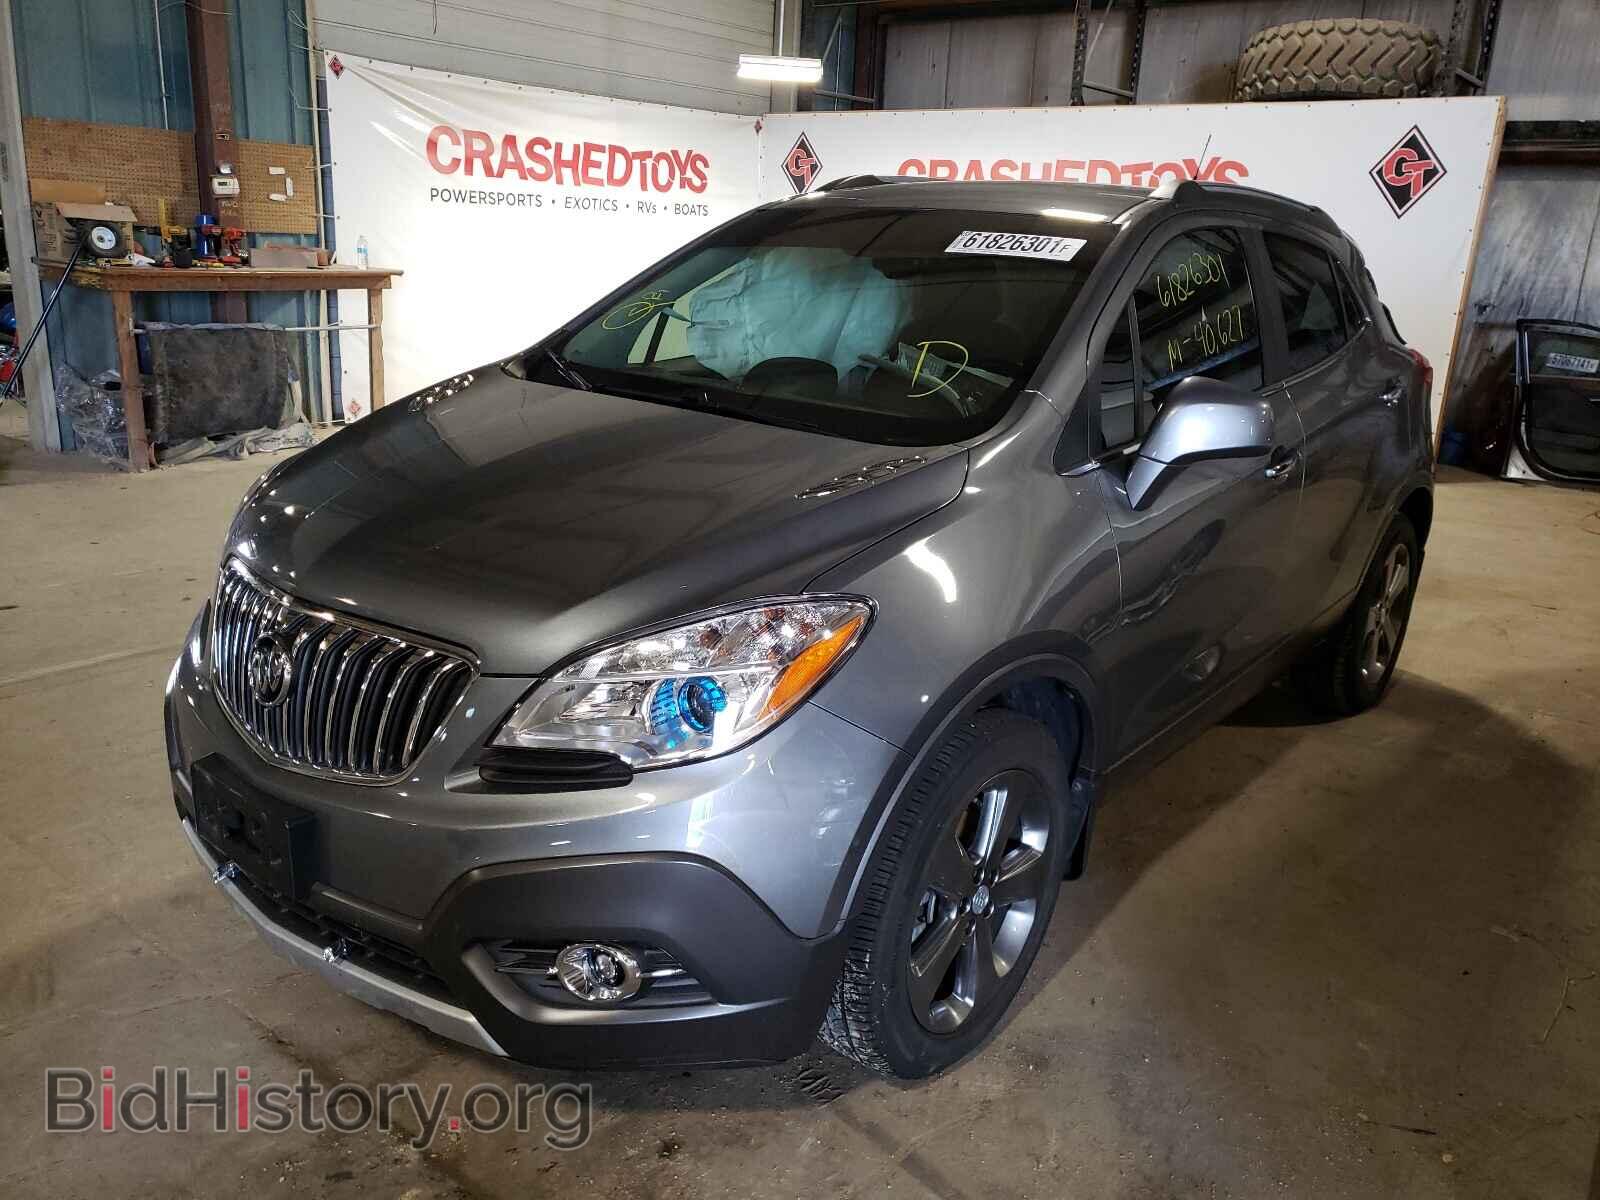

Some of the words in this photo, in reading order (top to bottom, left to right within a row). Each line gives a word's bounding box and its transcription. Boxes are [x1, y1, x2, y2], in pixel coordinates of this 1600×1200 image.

[426, 125, 709, 193] CRASHEDTOYS
[430, 187, 542, 207] POWERSPORTS
[564, 196, 618, 211] EXOTICS
[637, 201, 657, 214] RVs
[674, 203, 709, 216] BOATS
[962, 233, 1064, 254] 61826301
